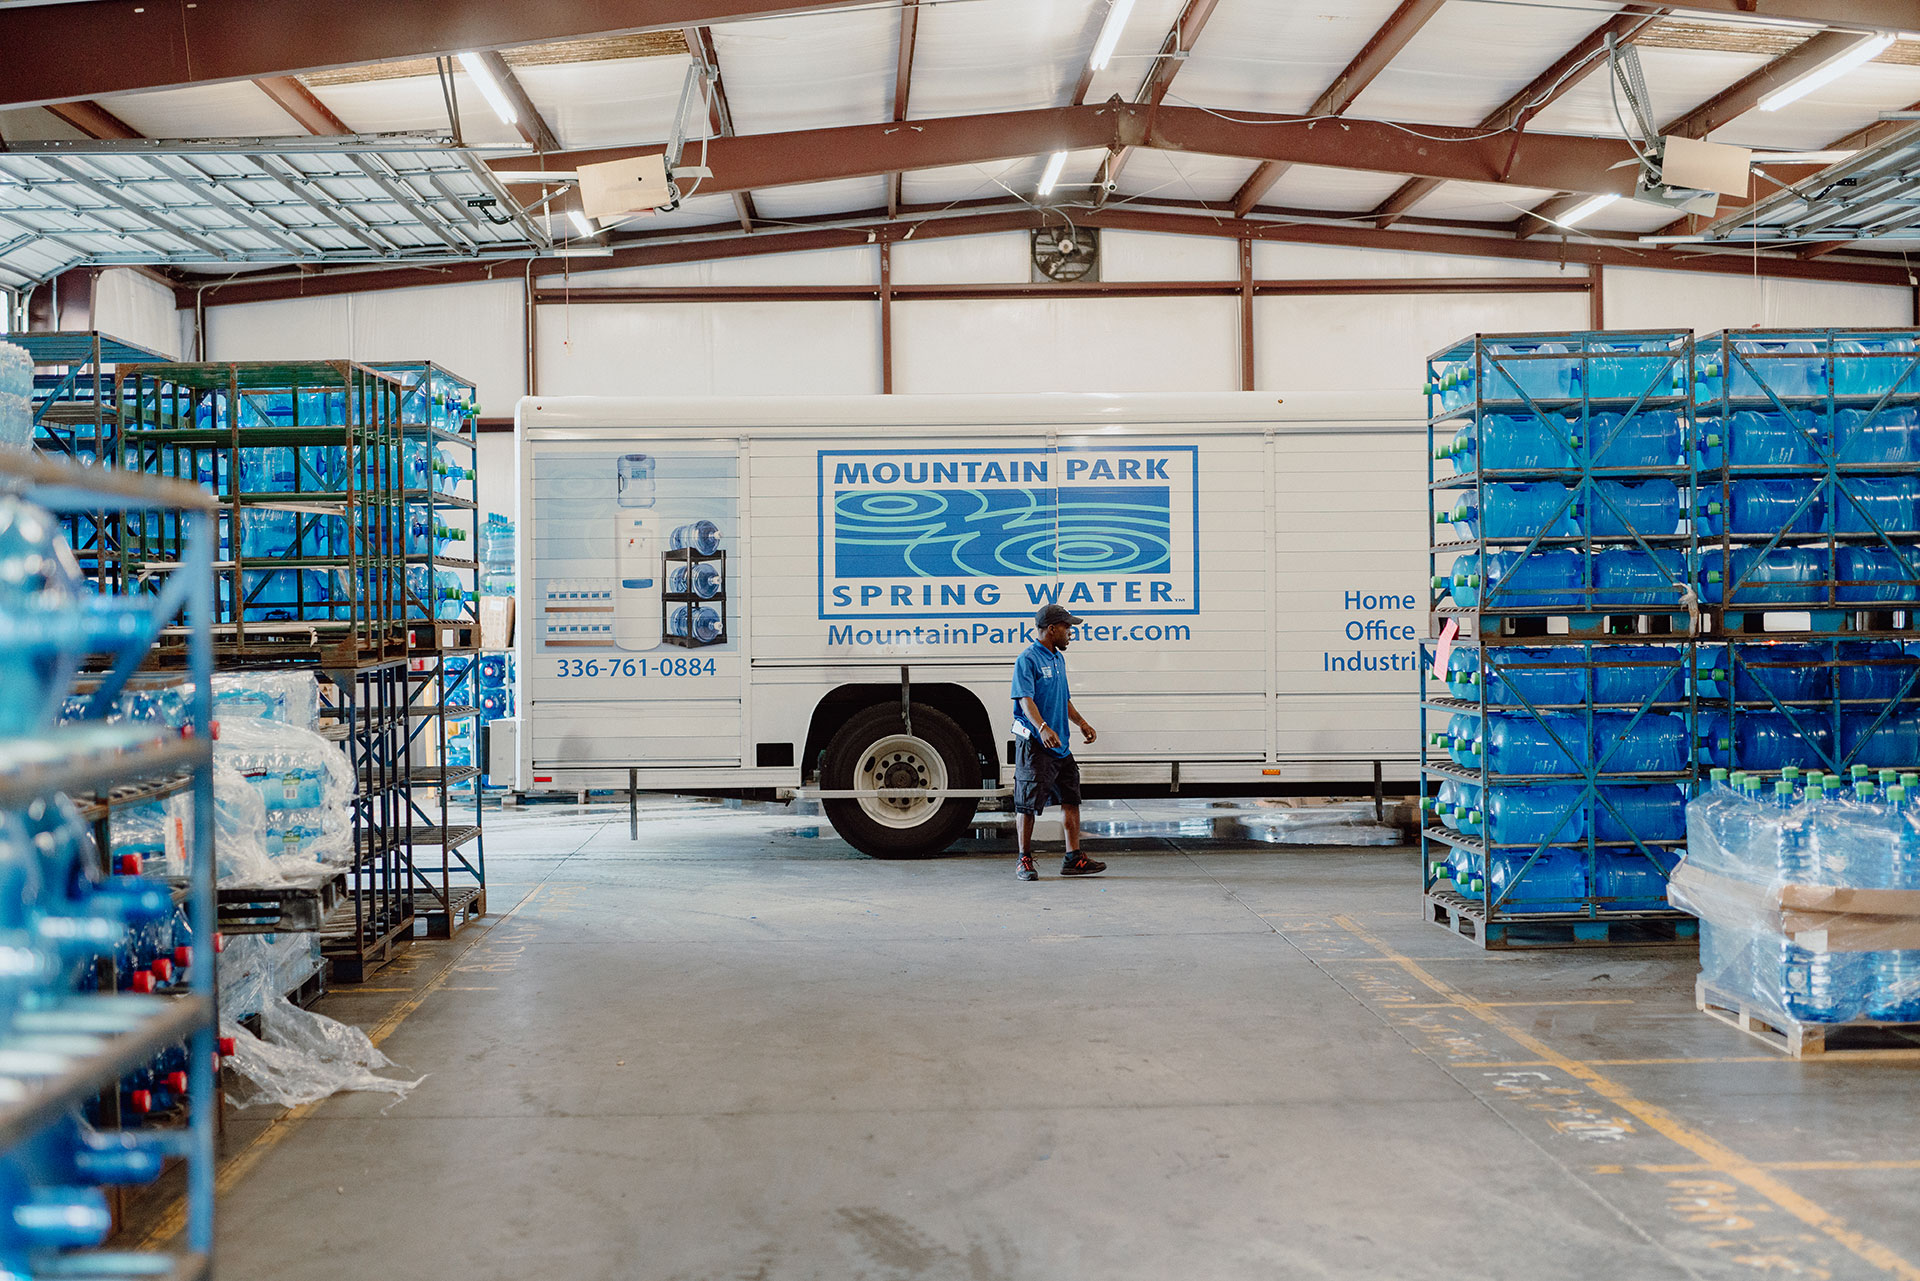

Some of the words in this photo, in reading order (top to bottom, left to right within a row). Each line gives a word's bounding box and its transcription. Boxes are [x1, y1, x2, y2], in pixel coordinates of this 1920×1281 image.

[834, 461, 1048, 484] MOUNTAIN
[1067, 458, 1170, 480] PARK
[832, 584, 1001, 607] SPRING
[1025, 581, 1173, 606] WATER
[1344, 590, 1416, 610] Home
[828, 622, 1190, 646] MountainParkater.com
[1345, 620, 1416, 641] Office
[557, 658, 717, 678] 336-761-0884
